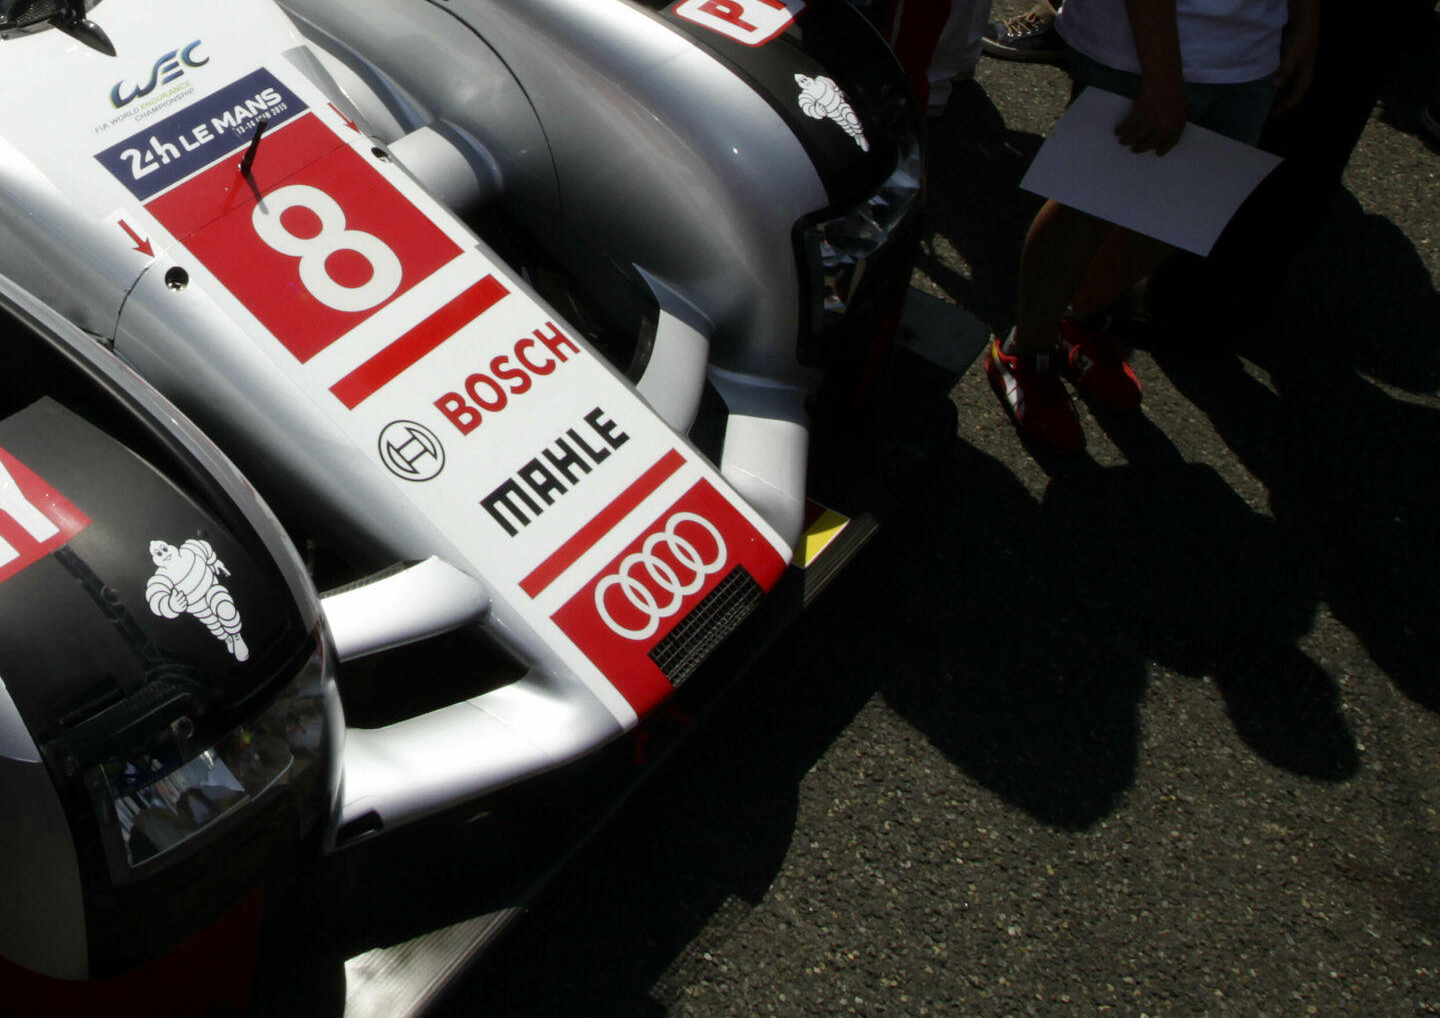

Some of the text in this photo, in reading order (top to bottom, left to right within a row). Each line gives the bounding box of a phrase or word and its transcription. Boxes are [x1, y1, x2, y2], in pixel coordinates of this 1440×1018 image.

[94, 79, 192, 134] FIA WORLD ENDURANCE
[110, 38, 210, 110] WEC
[134, 87, 195, 123] CHAMPIONSHIP
[120, 87, 283, 181] 24h LE MANS
[251, 184, 404, 313] 8
[432, 321, 581, 437] BOSCH
[479, 406, 631, 538] MAHLE
